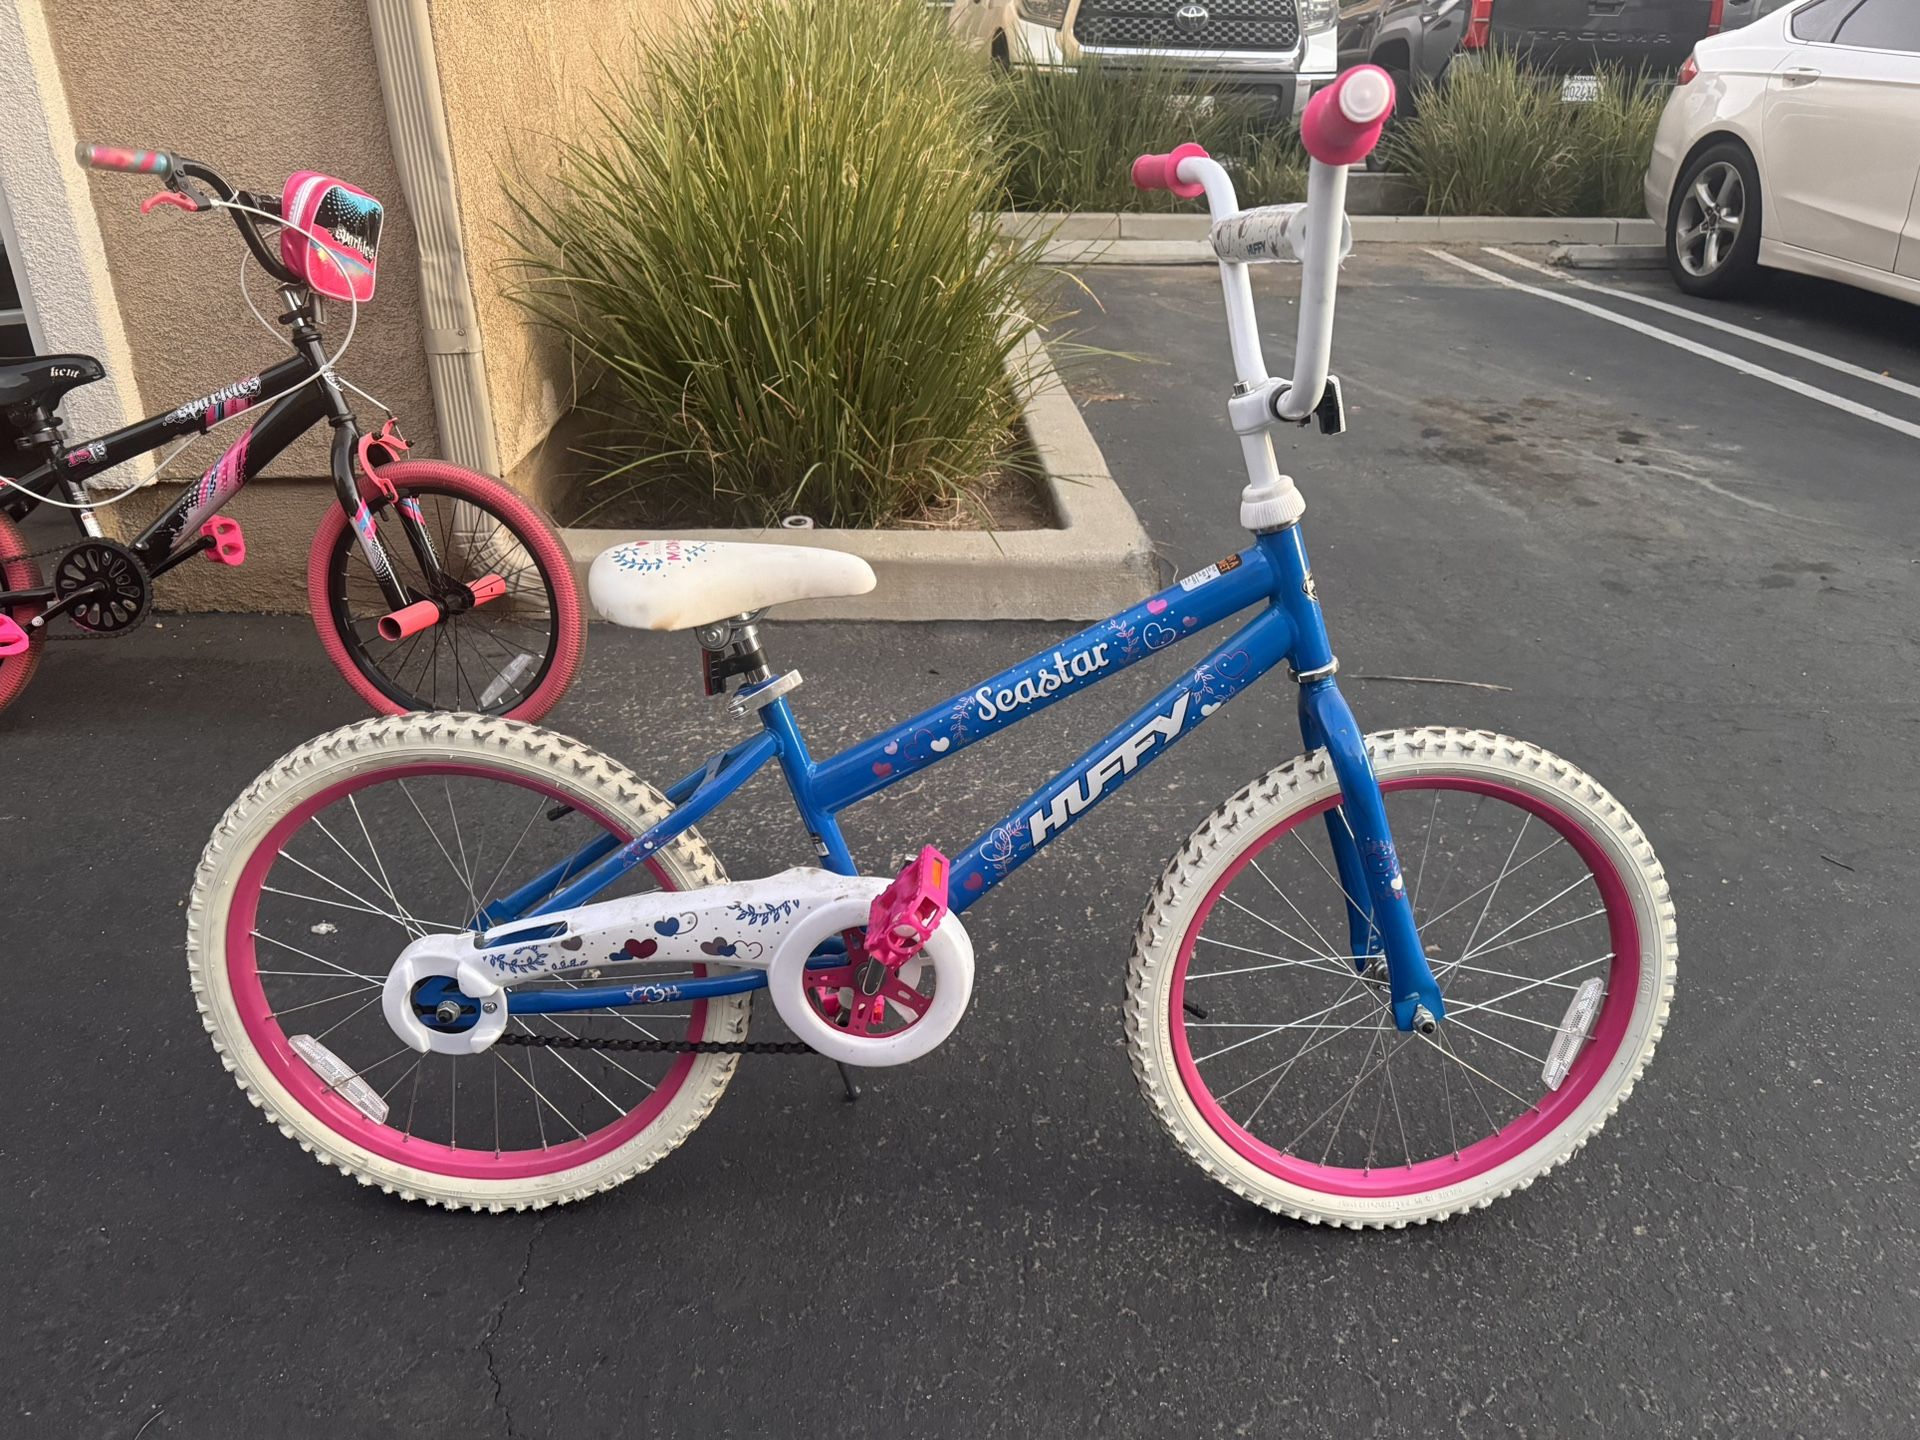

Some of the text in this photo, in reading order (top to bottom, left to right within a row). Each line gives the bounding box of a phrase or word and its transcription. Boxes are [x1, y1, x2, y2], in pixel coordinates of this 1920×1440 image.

[1527, 31, 1671, 43] TACOMA
[1246, 240, 1265, 255] HUFFY
[975, 642, 1110, 721] Seastar
[1029, 690, 1190, 847] HUFFY
